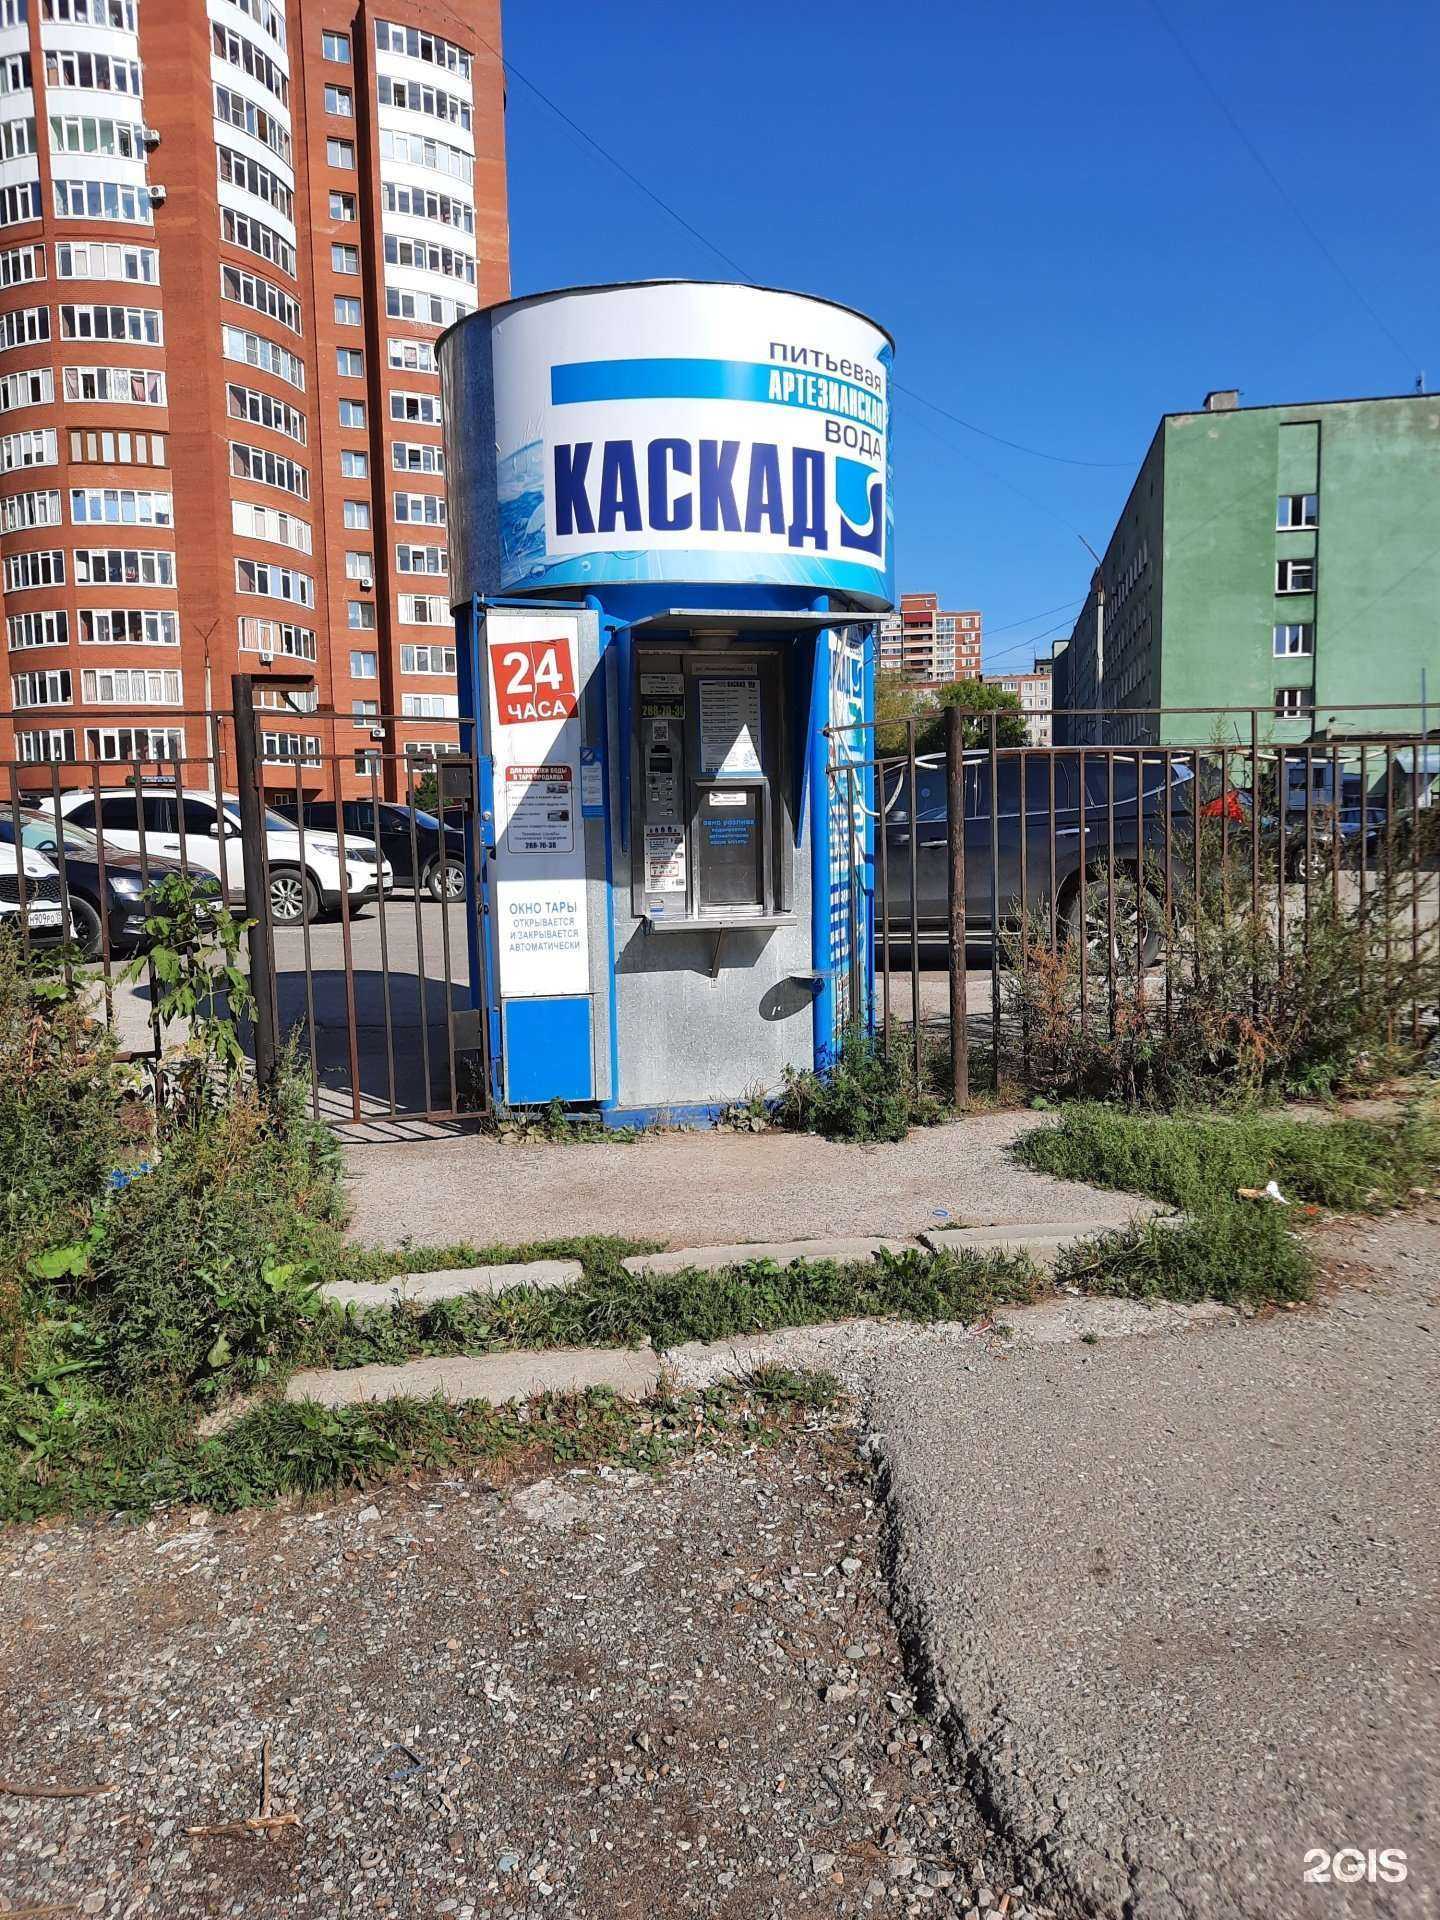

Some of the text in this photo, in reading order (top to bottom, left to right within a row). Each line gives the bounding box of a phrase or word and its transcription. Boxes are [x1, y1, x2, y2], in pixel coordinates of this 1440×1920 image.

[769, 369, 883, 432] АРТЕЗИАНСКАЯ
[553, 438, 828, 551] КАСКАД
[503, 648, 563, 694] 24
[507, 700, 568, 720] ЧАСА
[509, 901, 577, 915] ОКНО ТАРЫ
[513, 917, 575, 928] ОТКРЫВАЕТСЯ
[510, 929, 579, 940] И ЗАКРЫВАЕТСЯ
[509, 941, 580, 952] АВТОМАТИЧЕСКИ
